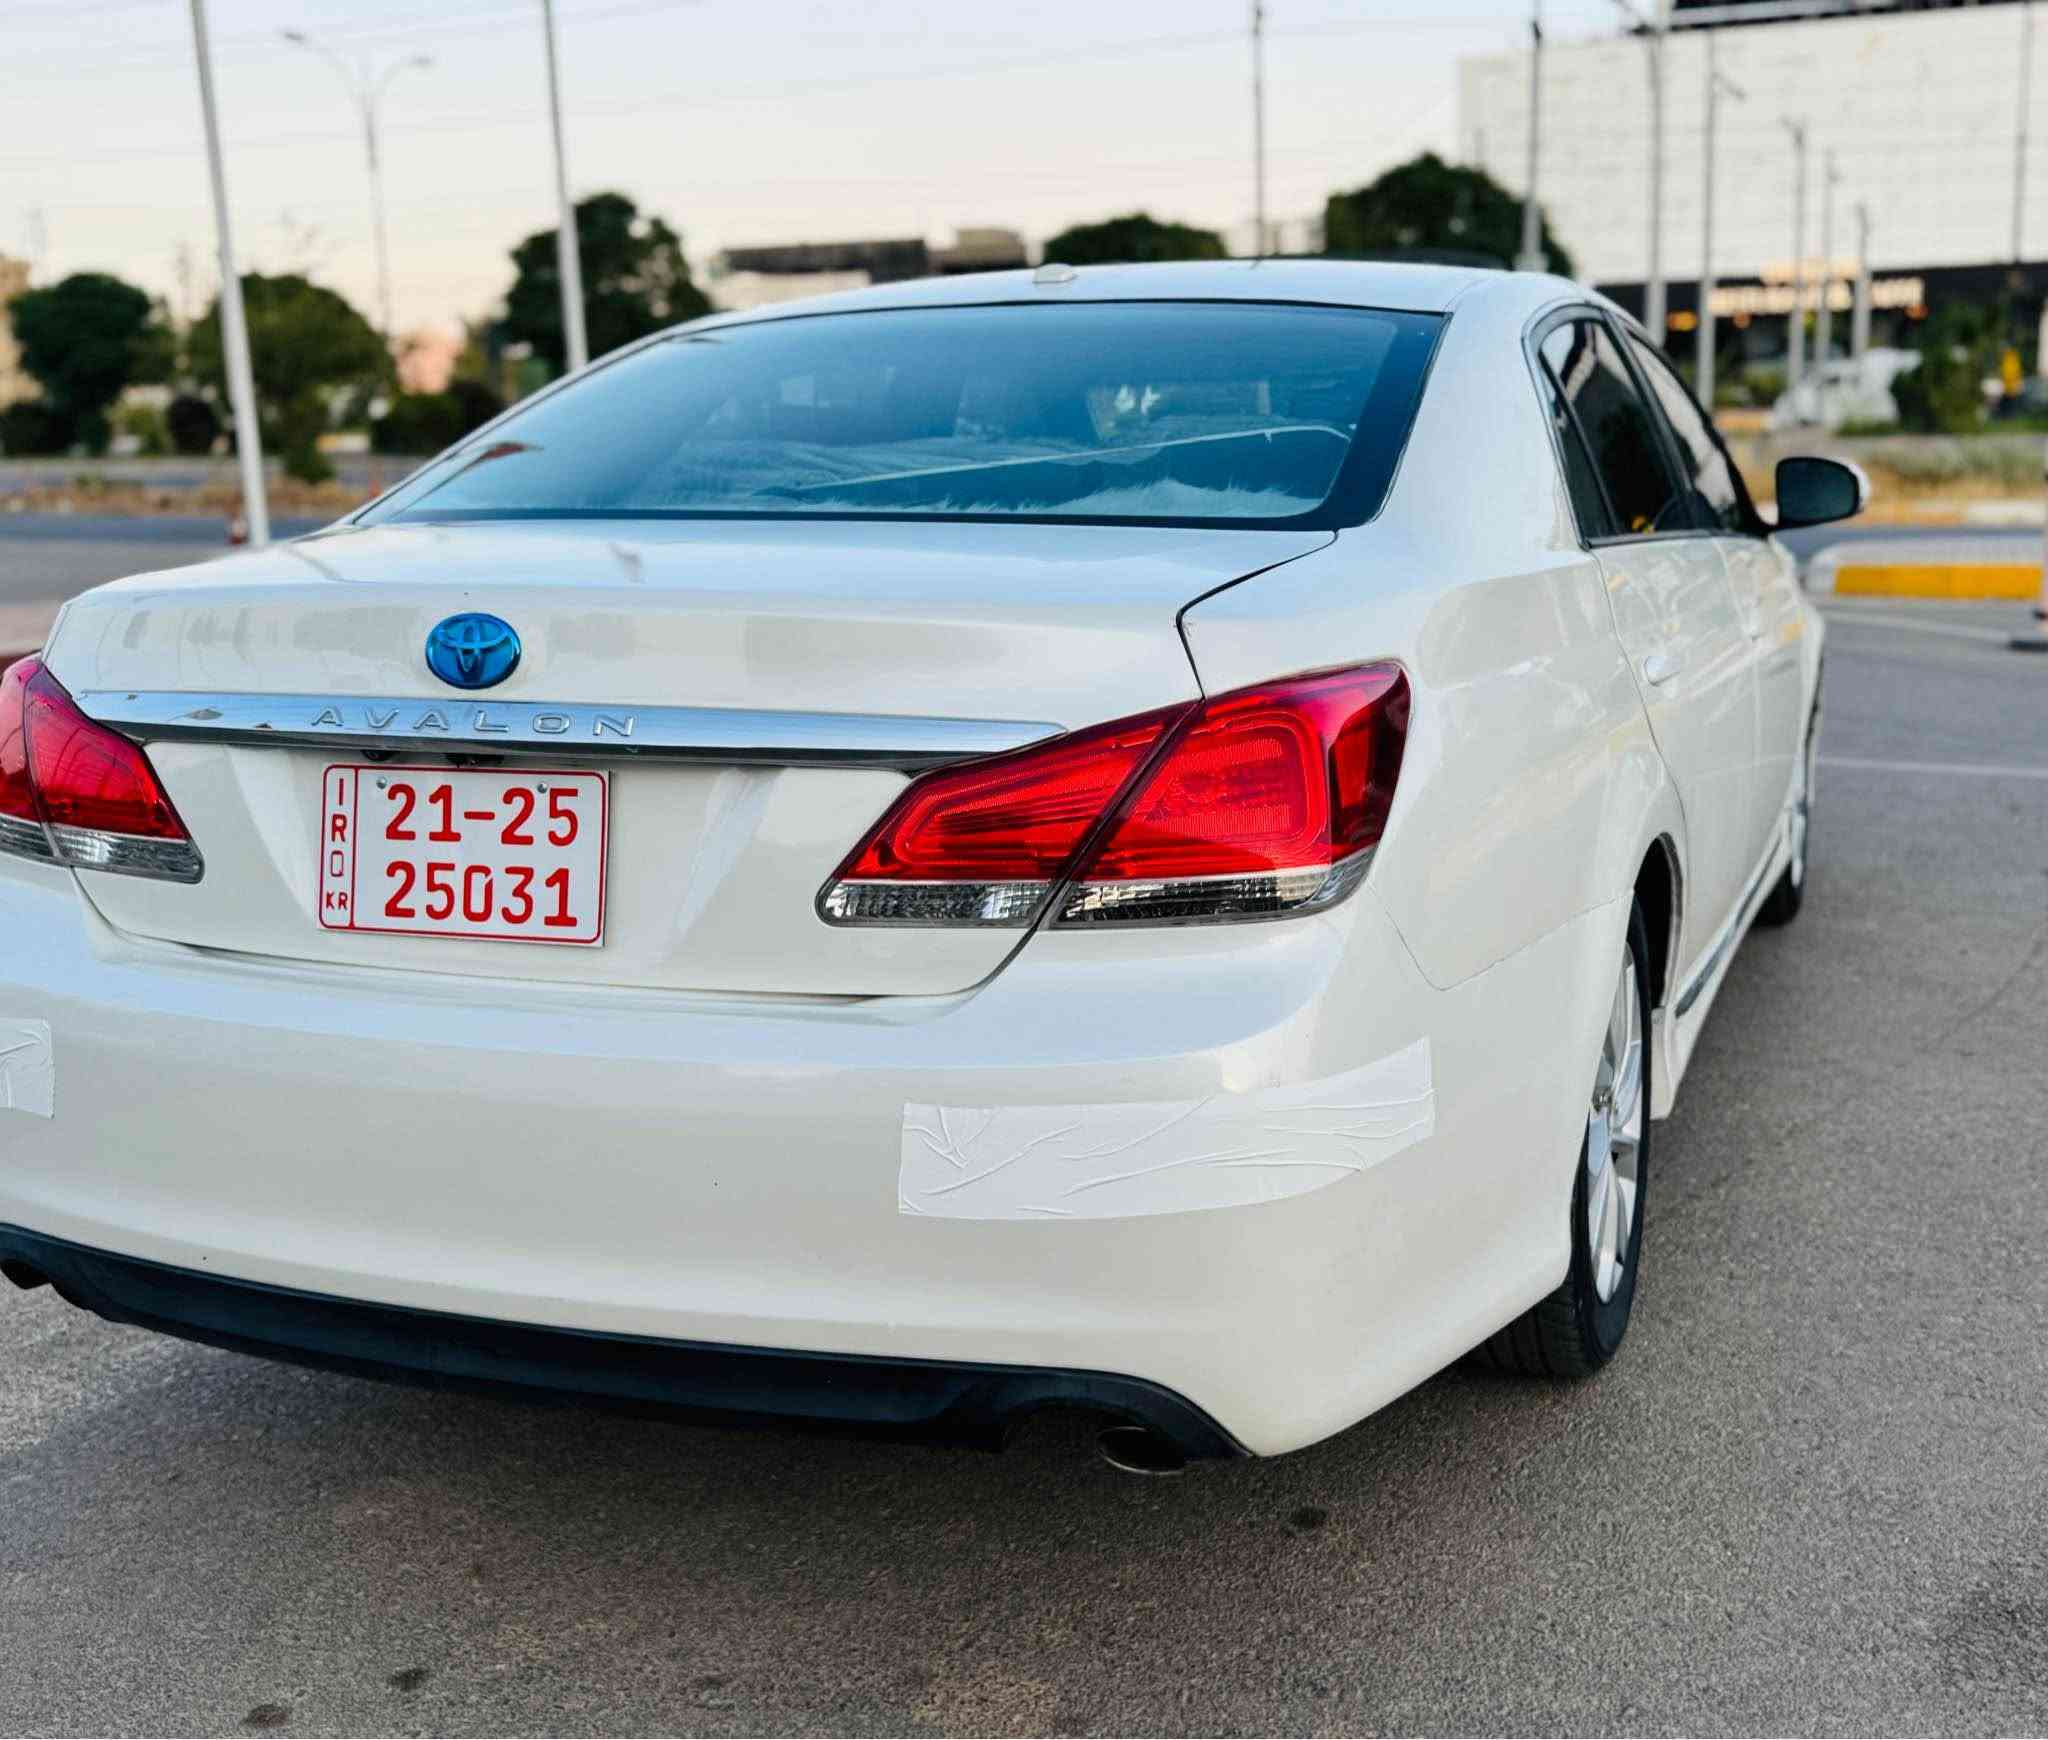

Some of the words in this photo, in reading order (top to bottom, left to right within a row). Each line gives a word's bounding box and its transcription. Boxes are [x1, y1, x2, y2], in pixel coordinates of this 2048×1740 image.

[311, 705, 636, 737] AVALON
[386, 783, 579, 847] 21-25
[326, 890, 348, 910] KR
[385, 860, 578, 927] 25031
